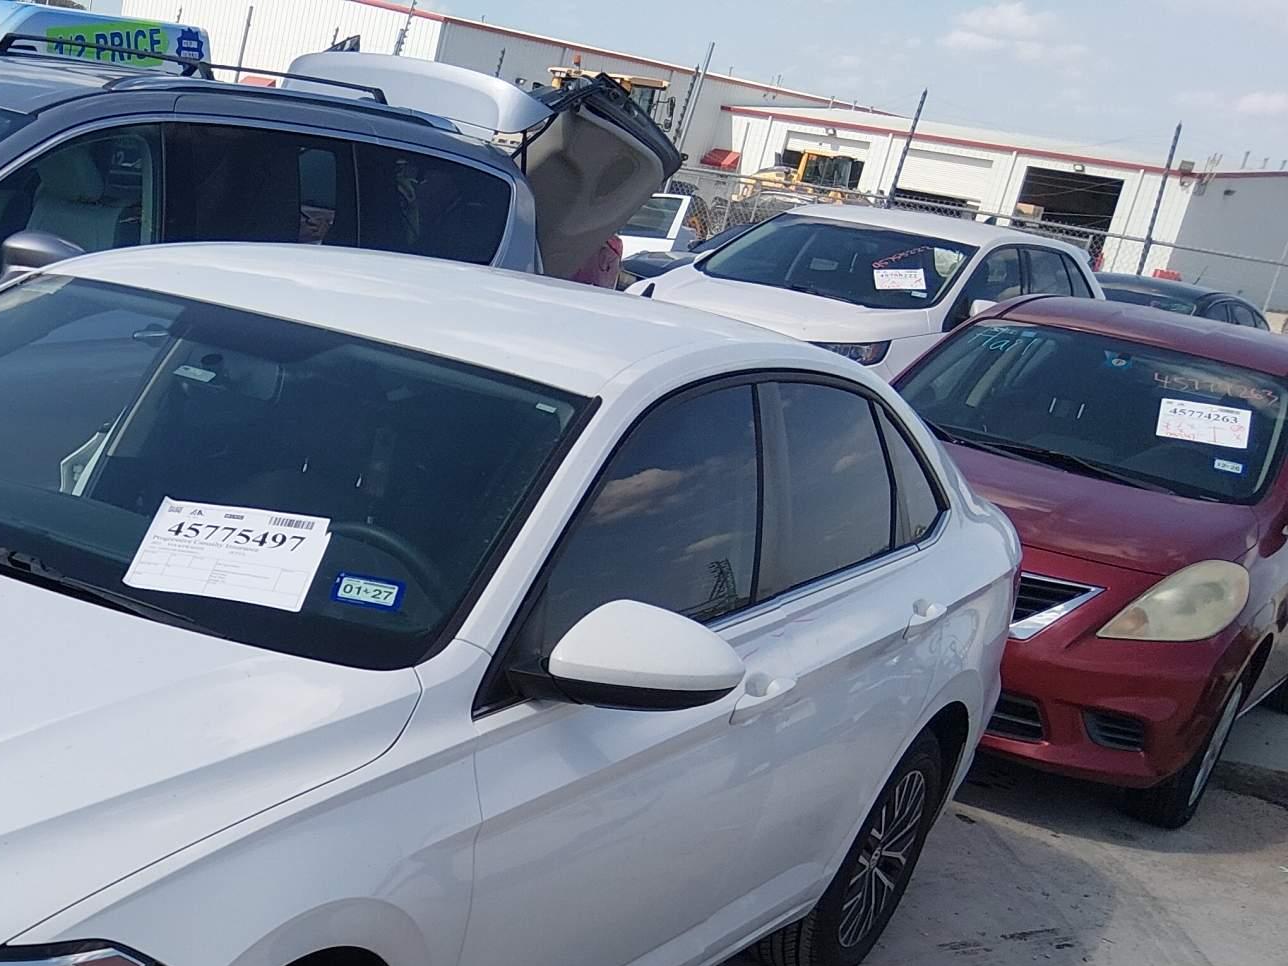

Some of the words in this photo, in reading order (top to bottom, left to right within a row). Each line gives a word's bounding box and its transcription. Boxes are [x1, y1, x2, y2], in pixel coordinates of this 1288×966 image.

[95, 28, 161, 62] PRICE
[1169, 408, 1238, 424] 45774263
[168, 521, 306, 551] 45775497
